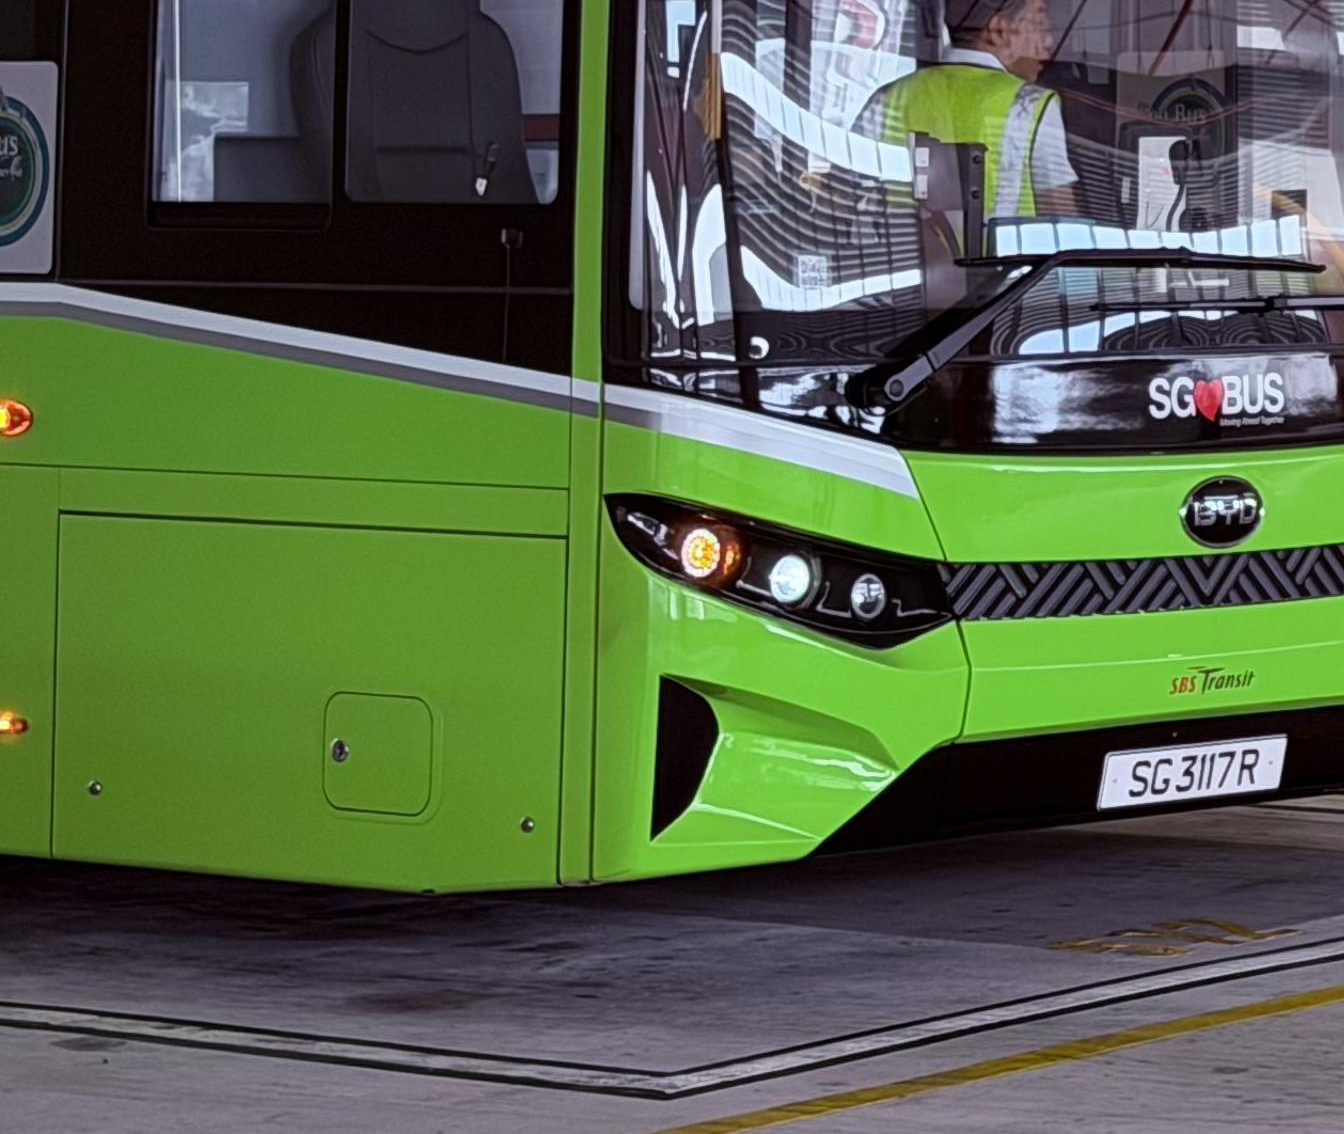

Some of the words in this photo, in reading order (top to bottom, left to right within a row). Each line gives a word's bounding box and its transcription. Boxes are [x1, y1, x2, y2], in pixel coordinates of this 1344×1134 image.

[1149, 376, 1196, 419] SG
[1221, 372, 1285, 415] BUS
[1194, 495, 1257, 526] BYD
[1169, 675, 1197, 695] SBS
[1197, 667, 1255, 695] Transit
[1128, 749, 1259, 797] SG3117R
